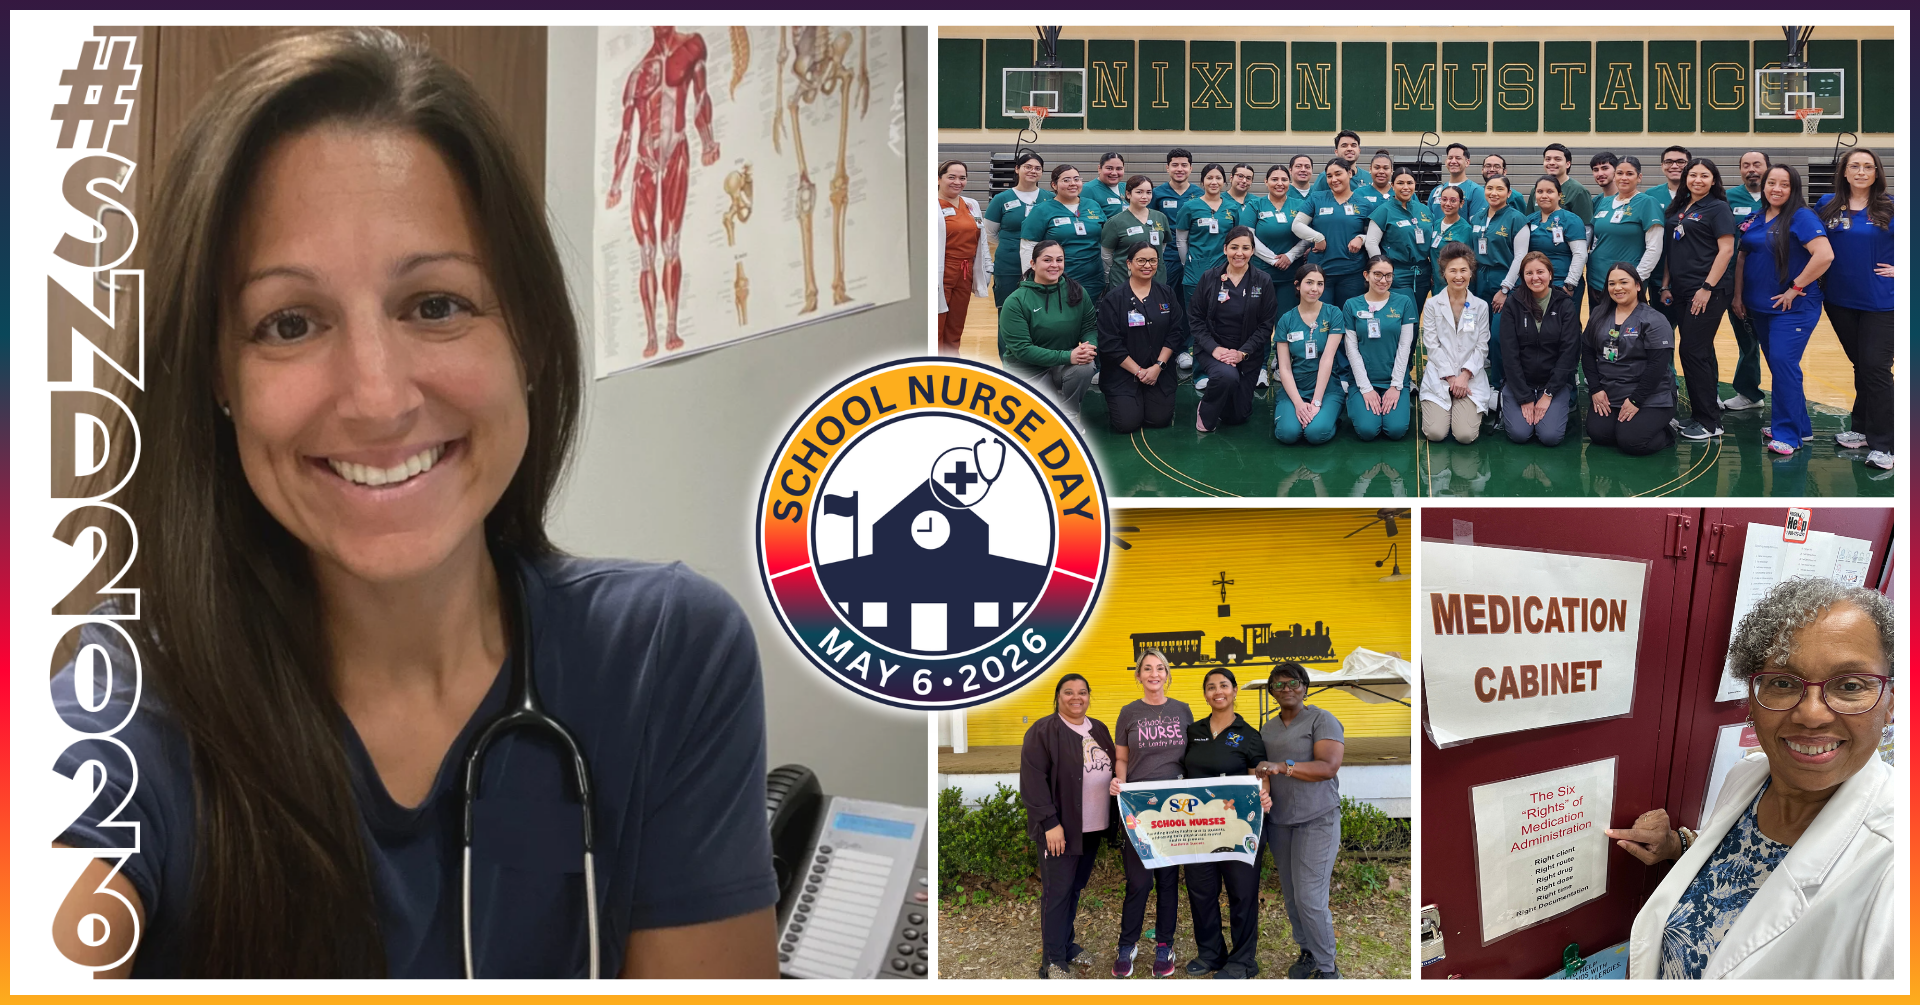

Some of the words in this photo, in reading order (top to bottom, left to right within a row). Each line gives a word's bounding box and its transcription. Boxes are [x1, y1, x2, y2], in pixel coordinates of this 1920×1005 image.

[1092, 61, 1331, 110] NIXON
[1430, 593, 1628, 635] MEDICATION
[1474, 660, 1603, 703] CABINET
[1137, 716, 1163, 727] School
[1138, 724, 1182, 741] NURSE
[1530, 791, 1554, 803] The
[1557, 785, 1575, 797] Six
[1572, 795, 1583, 807] of
[1151, 819, 1186, 829] SCHOOL
[1189, 817, 1226, 826] NURSES
[1521, 811, 1584, 836] Medication
[1511, 821, 1592, 853] Administration
[1534, 854, 1555, 865] Right
[1556, 846, 1576, 858] client
[1535, 863, 1555, 874] Right
[1556, 856, 1574, 867] route
[1536, 873, 1556, 884] Right
[1557, 866, 1573, 876] drug
[1536, 882, 1555, 893] Right
[1557, 875, 1574, 885] dose
[1516, 906, 1536, 917] Right
[1538, 885, 1589, 909] Documentation
[1536, 890, 1556, 901] Right
[1557, 884, 1573, 894] time
[1590, 962, 1608, 974] WITH
